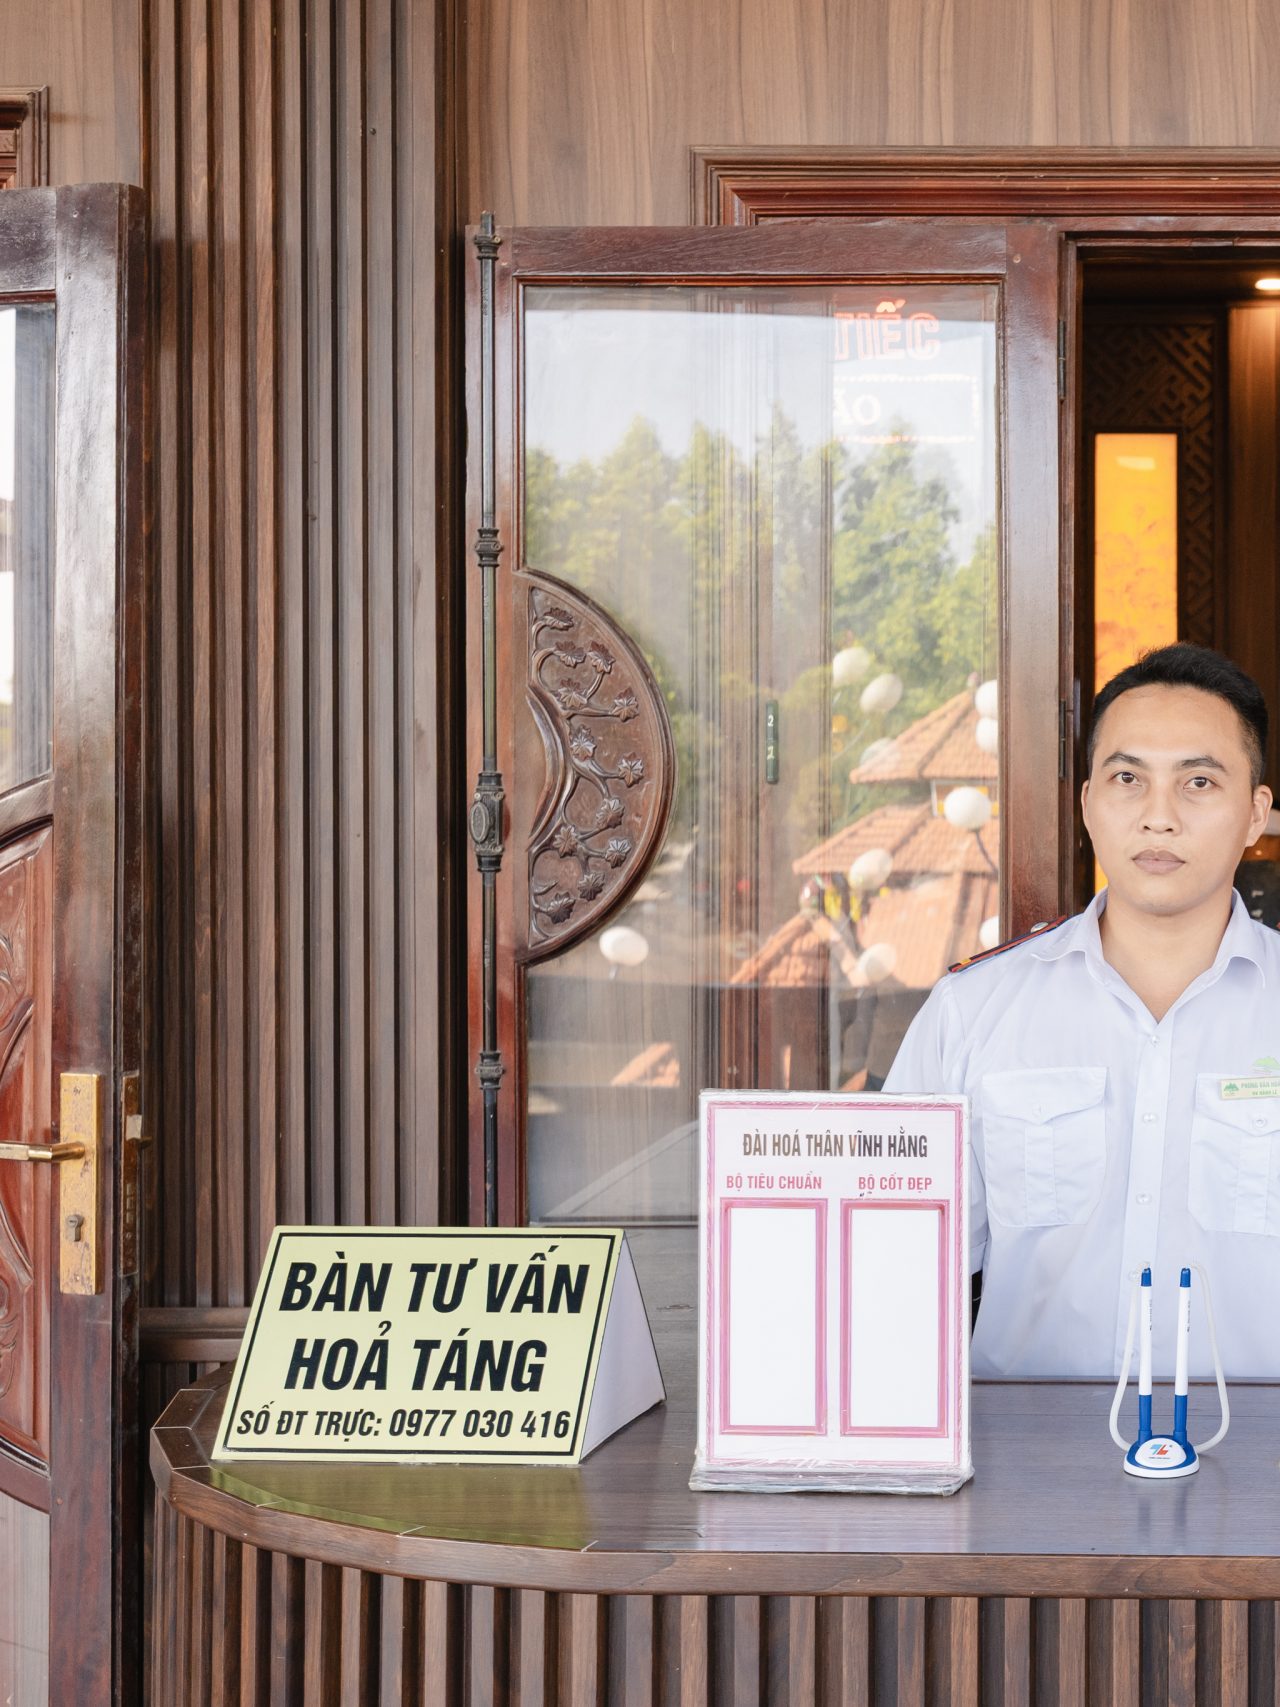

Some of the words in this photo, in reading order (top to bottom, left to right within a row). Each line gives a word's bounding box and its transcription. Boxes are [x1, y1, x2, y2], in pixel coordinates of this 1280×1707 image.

[742, 1128, 767, 1156] ĐÀI
[772, 1129, 801, 1157] HOÁ
[806, 1129, 844, 1157] THÂN
[849, 1130, 883, 1157] VĨNH
[887, 1126, 928, 1158] HẰNG
[726, 1173, 743, 1192] BỘ
[747, 1173, 774, 1189] TIÊU
[779, 1171, 822, 1189] CHUẨN
[880, 1172, 904, 1190] CỐT
[907, 1176, 933, 1193] ĐẸP
[279, 1251, 393, 1312] BÀN
[407, 1258, 478, 1313] TƯ
[486, 1245, 590, 1314] VẤN
[284, 1320, 392, 1390] HOẢ
[411, 1328, 548, 1392] TÁNG
[236, 1401, 275, 1435] SỐ
[276, 1410, 308, 1435] ĐT
[315, 1409, 382, 1442] TRỰC:
[389, 1409, 457, 1437] 0977
[463, 1409, 513, 1438] 030
[521, 1410, 571, 1438] 416
